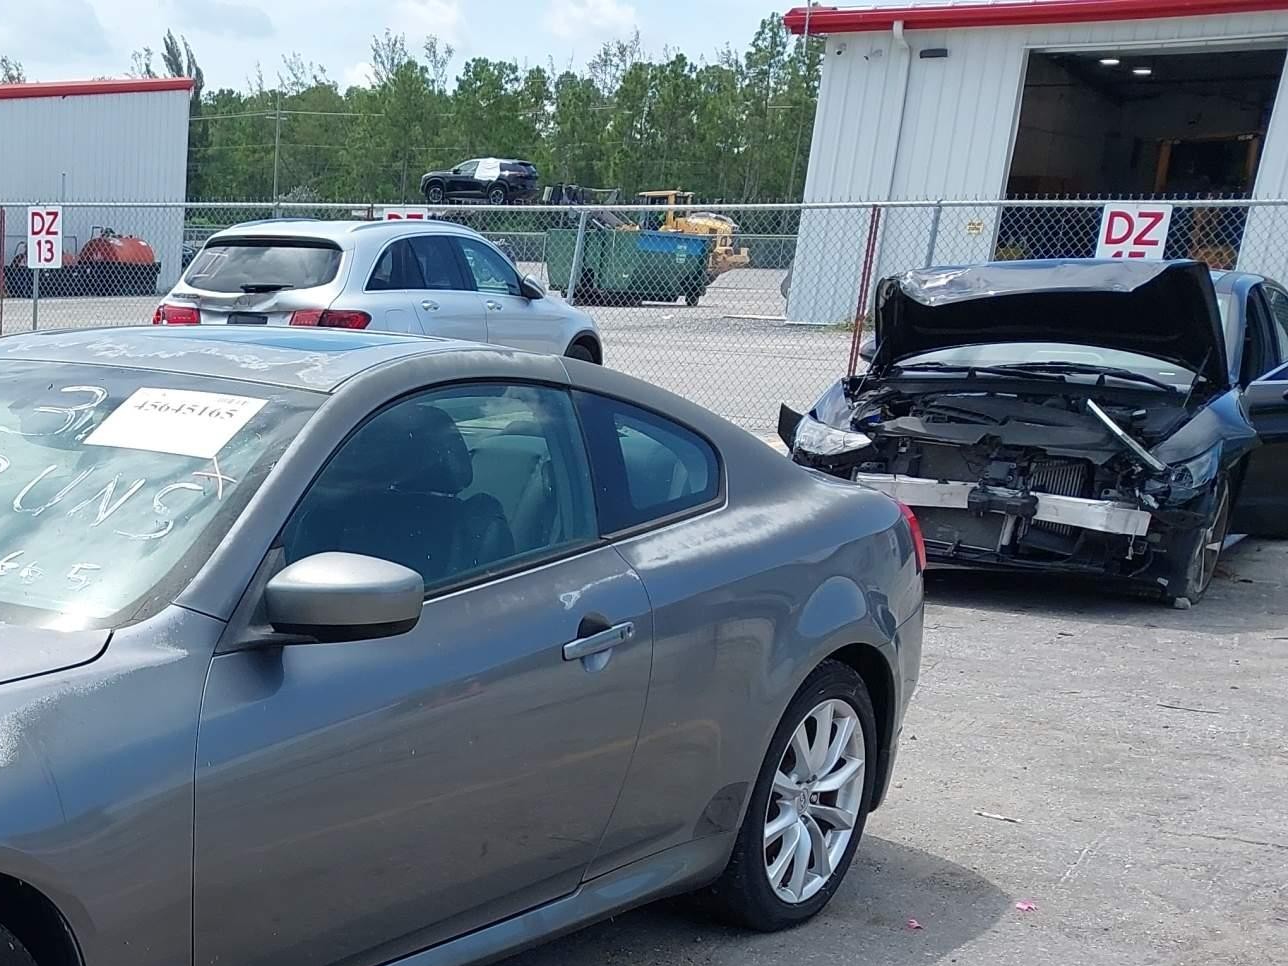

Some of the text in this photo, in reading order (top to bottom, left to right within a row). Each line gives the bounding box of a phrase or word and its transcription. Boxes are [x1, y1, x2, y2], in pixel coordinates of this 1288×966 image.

[31, 211, 59, 236] DZ
[1104, 210, 1165, 246] DZ
[36, 239, 54, 263] 13
